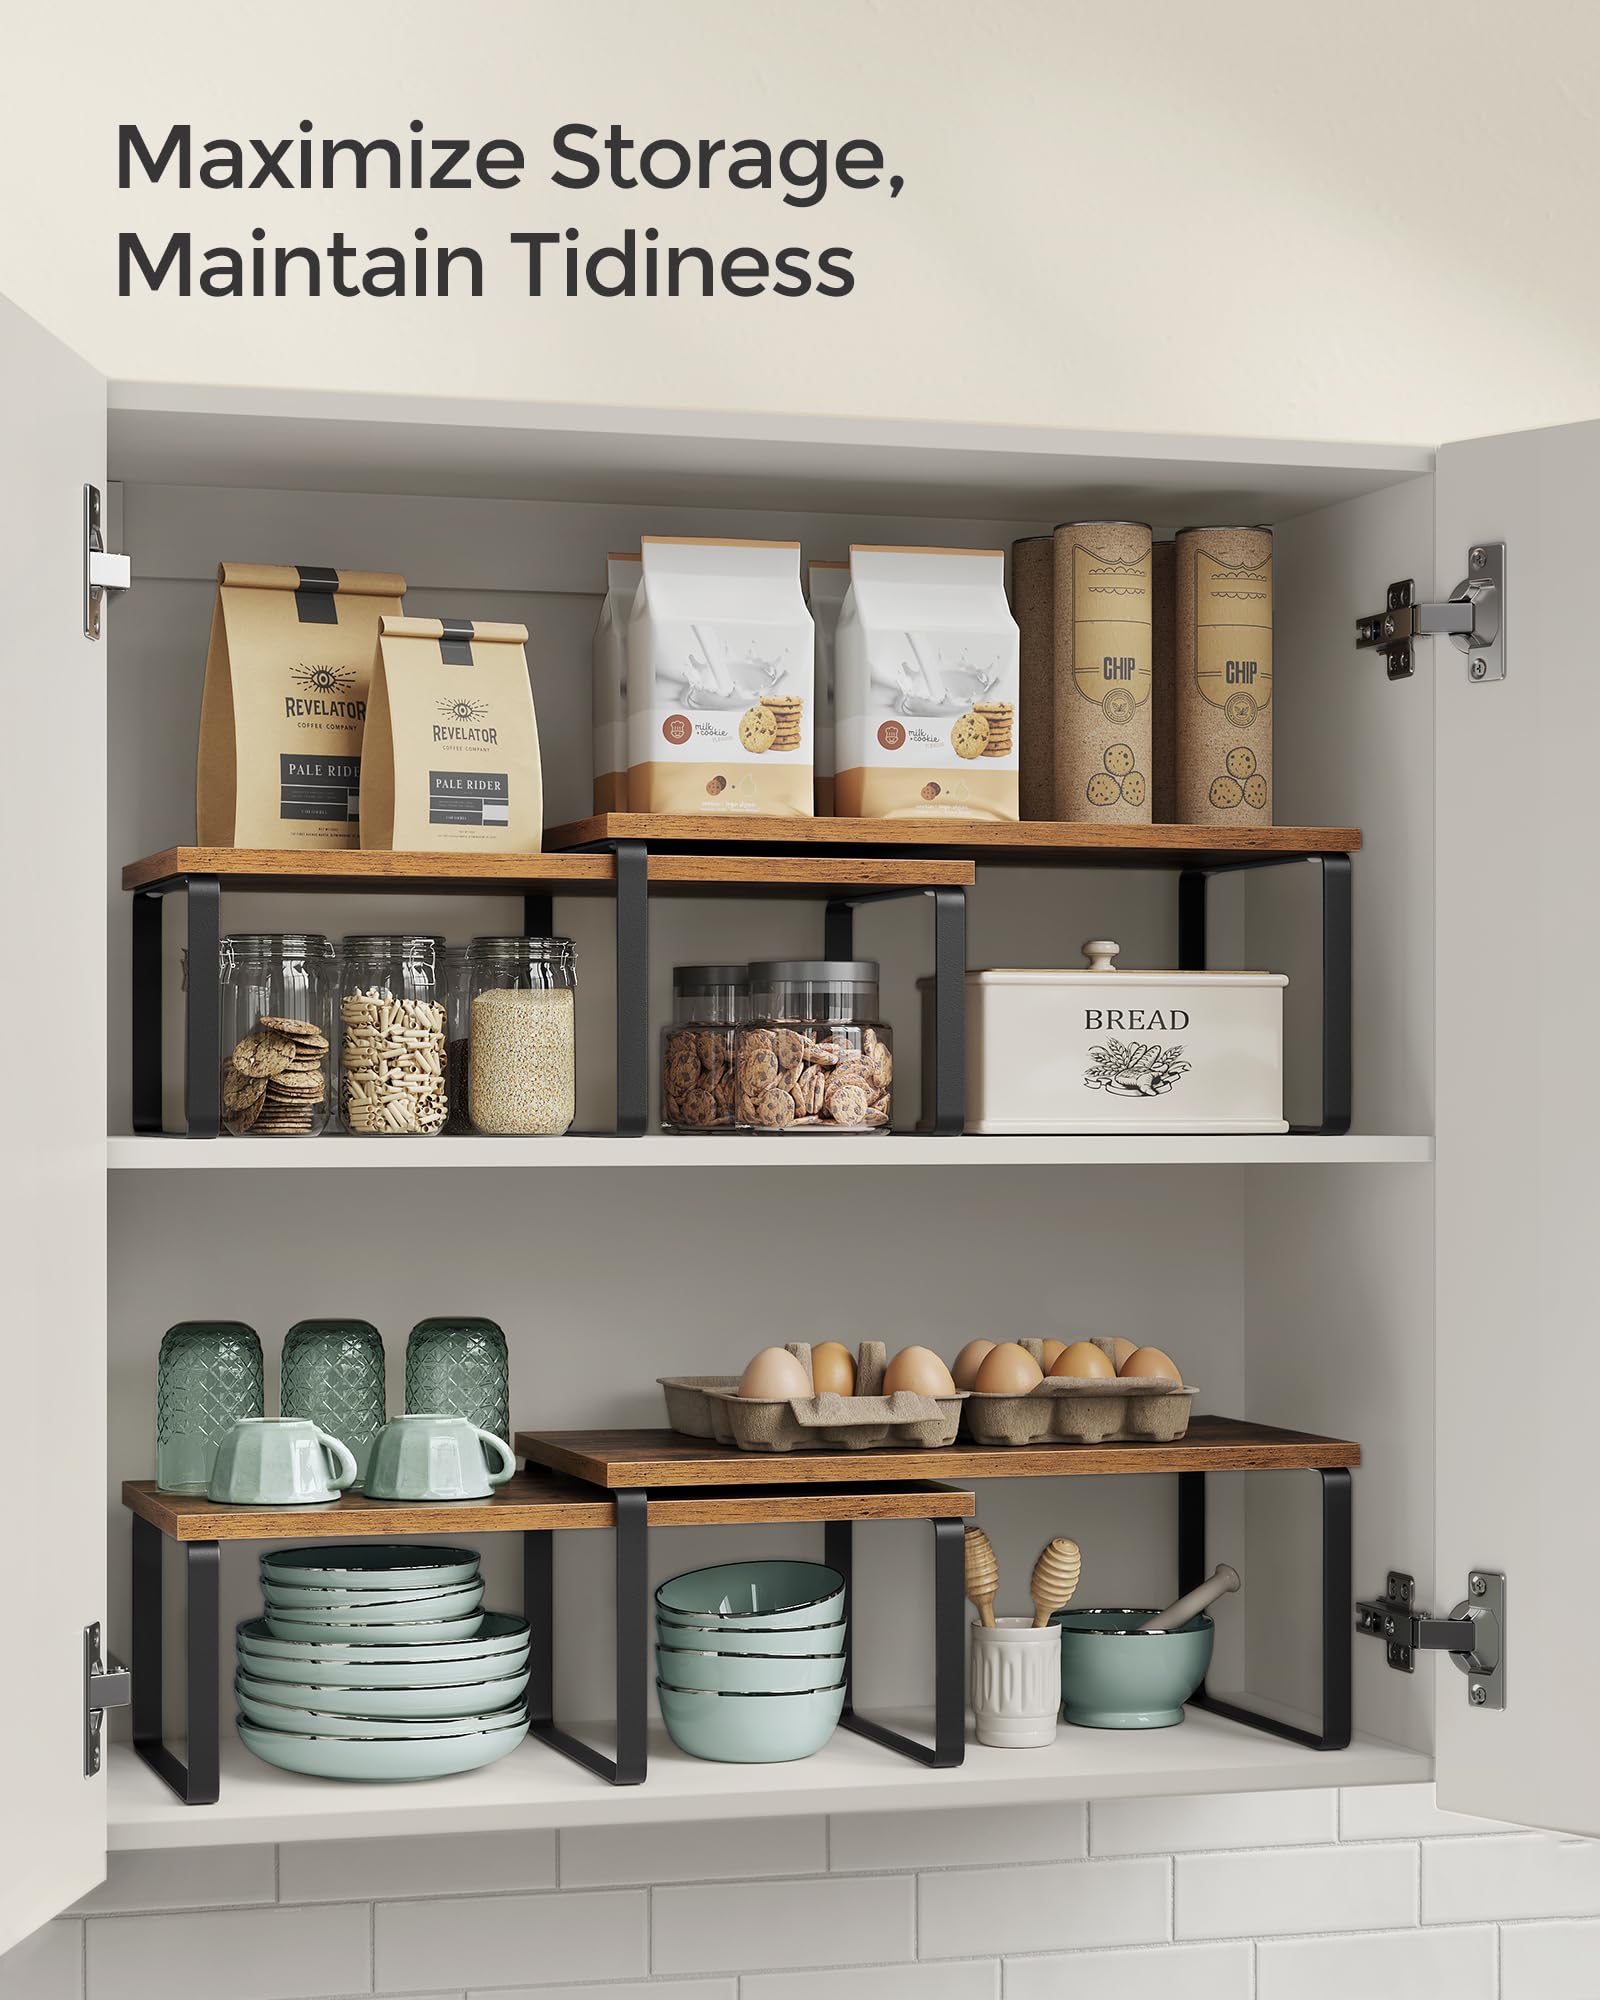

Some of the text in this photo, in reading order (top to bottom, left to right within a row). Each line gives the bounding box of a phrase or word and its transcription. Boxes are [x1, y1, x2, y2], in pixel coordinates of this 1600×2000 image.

[1103, 656, 1136, 680] CHIP
[1225, 660, 1258, 684] CHIP
[284, 696, 367, 722] REVELATOR
[297, 722, 357, 732] COFFEE COMPANY
[432, 724, 498, 745] REVELATOR
[288, 763, 360, 777] PALE RIDE
[436, 778, 502, 791] PALE RIDER
[1084, 1009, 1190, 1030] BREAD
